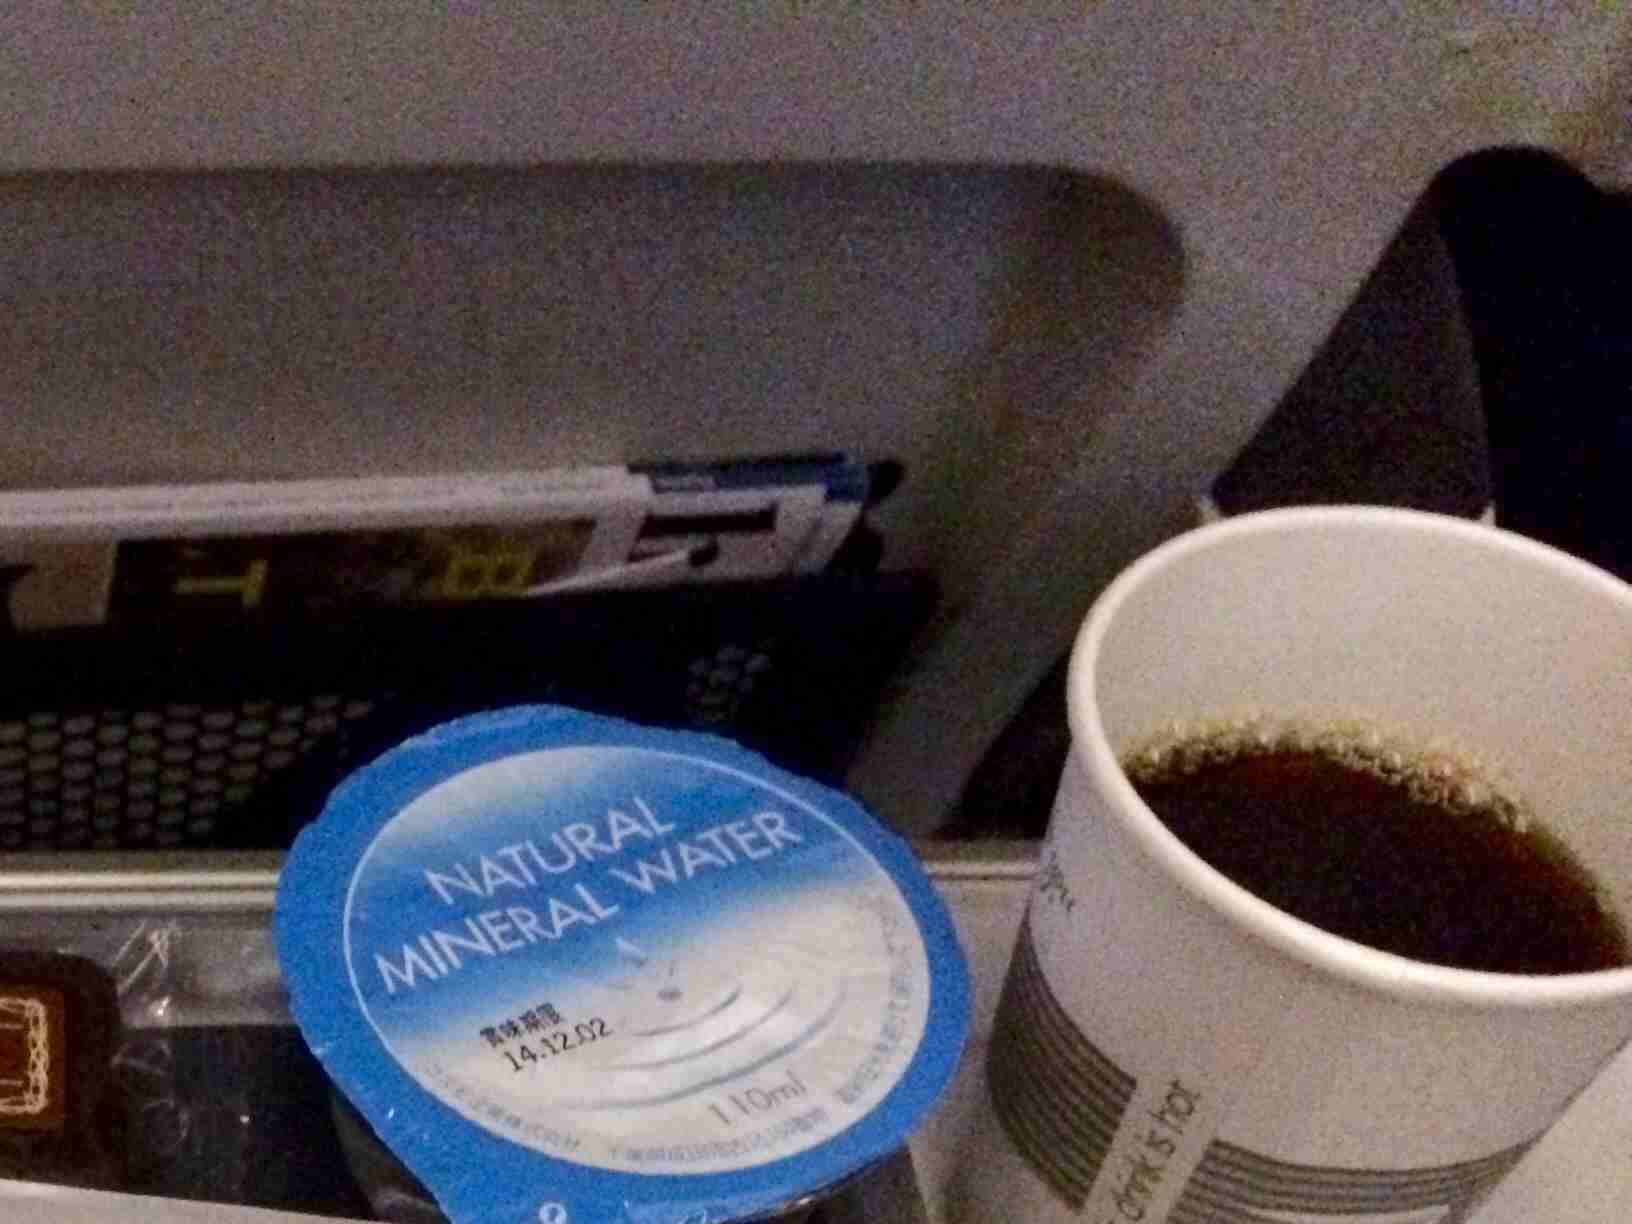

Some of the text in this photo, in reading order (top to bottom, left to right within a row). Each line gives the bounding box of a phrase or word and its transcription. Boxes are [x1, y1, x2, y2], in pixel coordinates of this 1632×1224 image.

[424, 796, 677, 904] NATURAL
[374, 809, 806, 995] MINERAL WATER
[503, 1017, 614, 1072] 14.12.02
[707, 1070, 808, 1128] 110ml
[1145, 1078, 1202, 1138] hot
